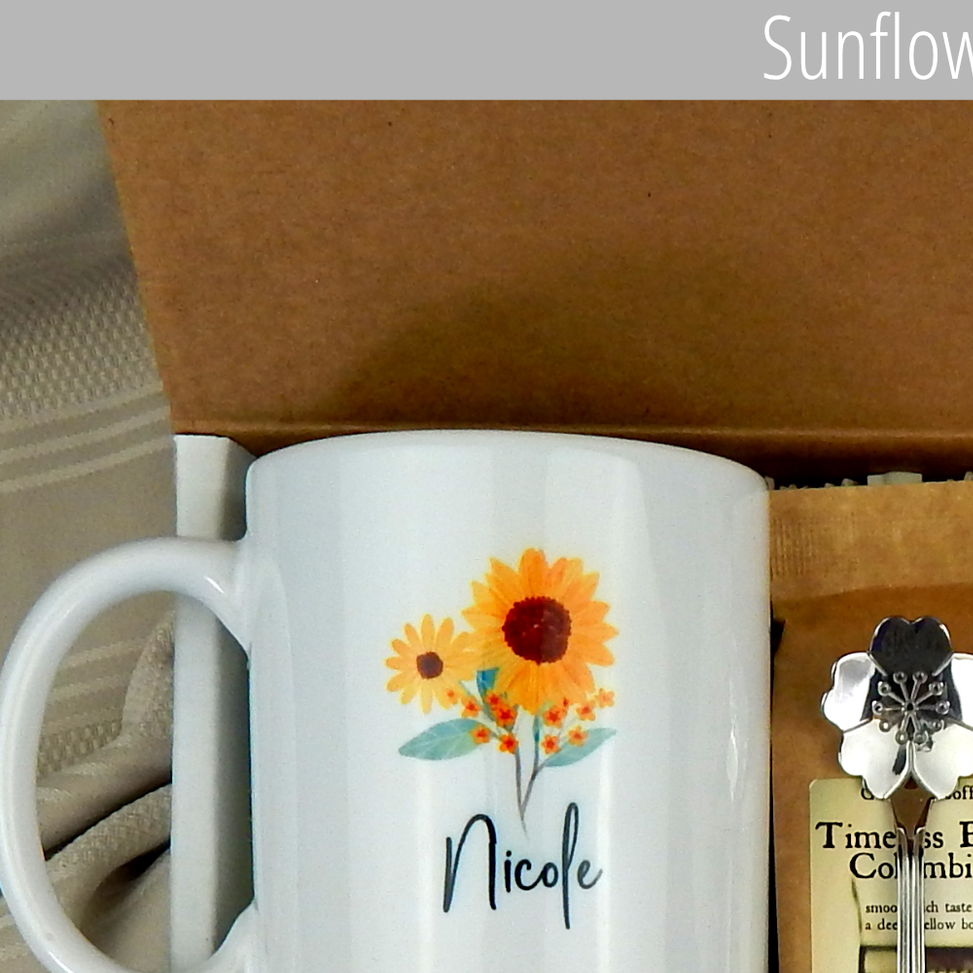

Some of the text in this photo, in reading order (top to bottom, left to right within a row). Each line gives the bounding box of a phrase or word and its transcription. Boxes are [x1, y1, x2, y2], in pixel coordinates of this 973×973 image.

[442, 798, 604, 931] Nicole
[944, 903, 973, 914] taste
[864, 921, 872, 931] a
[923, 917, 956, 931] ellow
